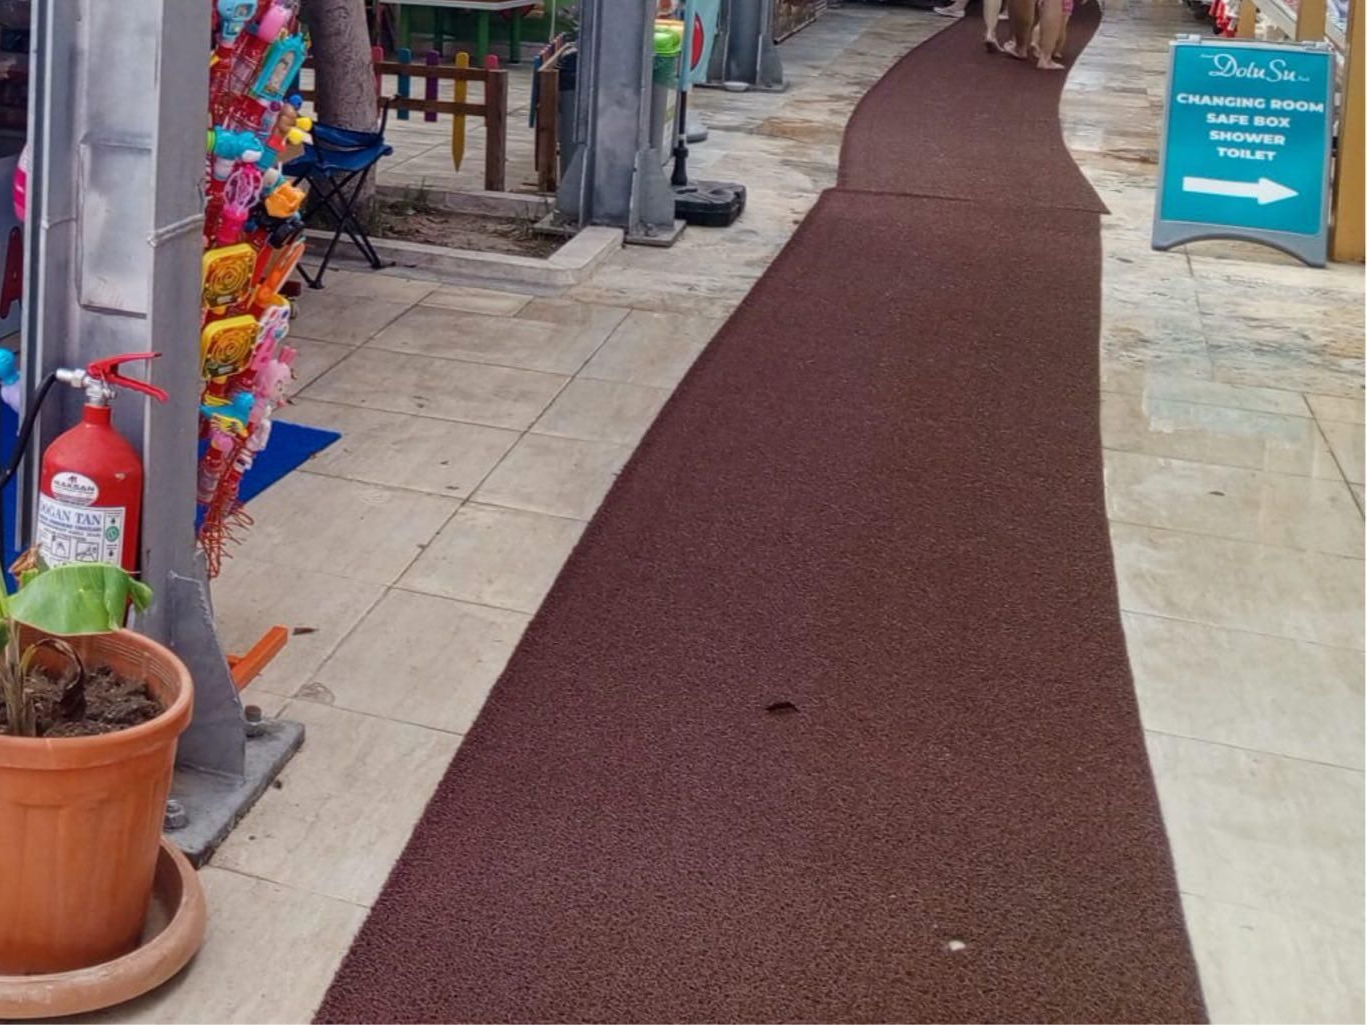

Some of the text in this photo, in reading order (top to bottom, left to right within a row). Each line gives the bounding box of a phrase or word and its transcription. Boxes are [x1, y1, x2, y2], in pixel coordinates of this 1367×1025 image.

[1265, 58, 1297, 83] Su
[1176, 93, 1324, 113] CHANGING ROOM
[1206, 112, 1291, 128] SAFE BOX
[1209, 129, 1286, 145] SHOWER
[1216, 146, 1276, 161] TOILET
